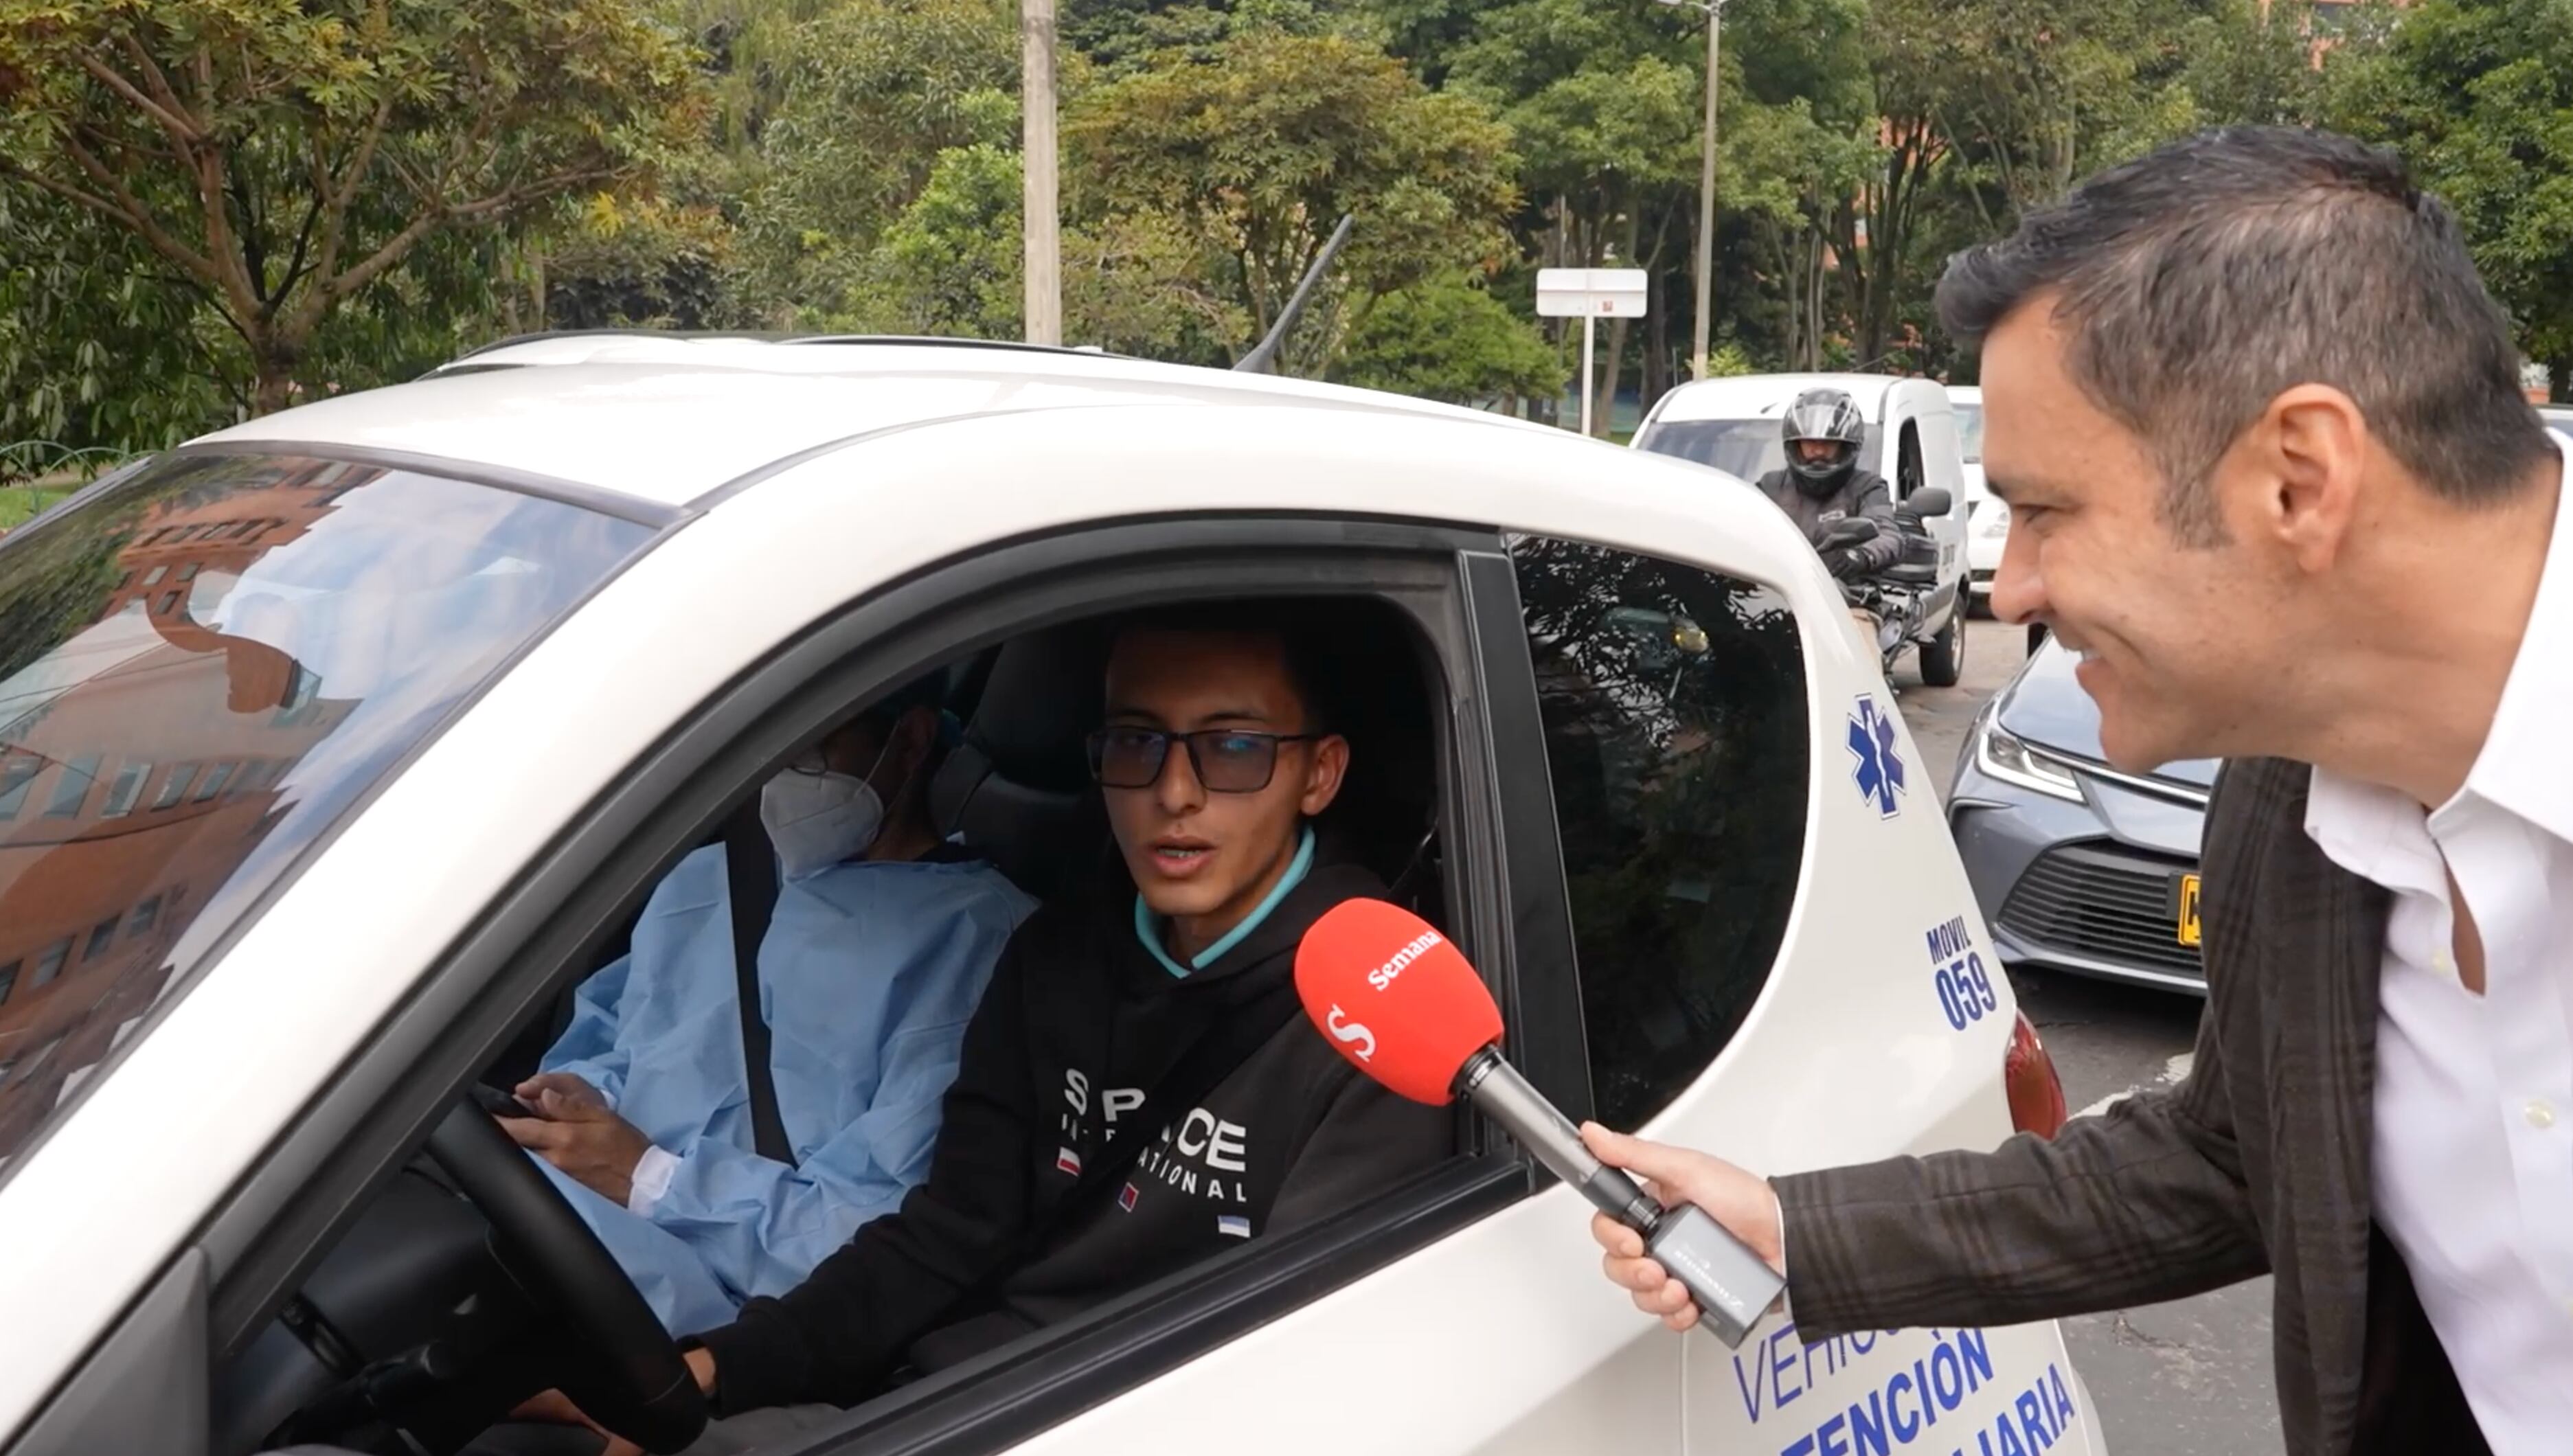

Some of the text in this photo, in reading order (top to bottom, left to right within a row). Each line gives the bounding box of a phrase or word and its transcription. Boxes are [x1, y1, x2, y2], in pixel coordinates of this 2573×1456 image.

[1368, 931, 1442, 991] Semana
[1926, 914, 1972, 965] MOVIL
[1935, 951, 1997, 1031] 059
[1326, 1003, 1376, 1062] S
[1065, 1068, 1246, 1172] SPCE
